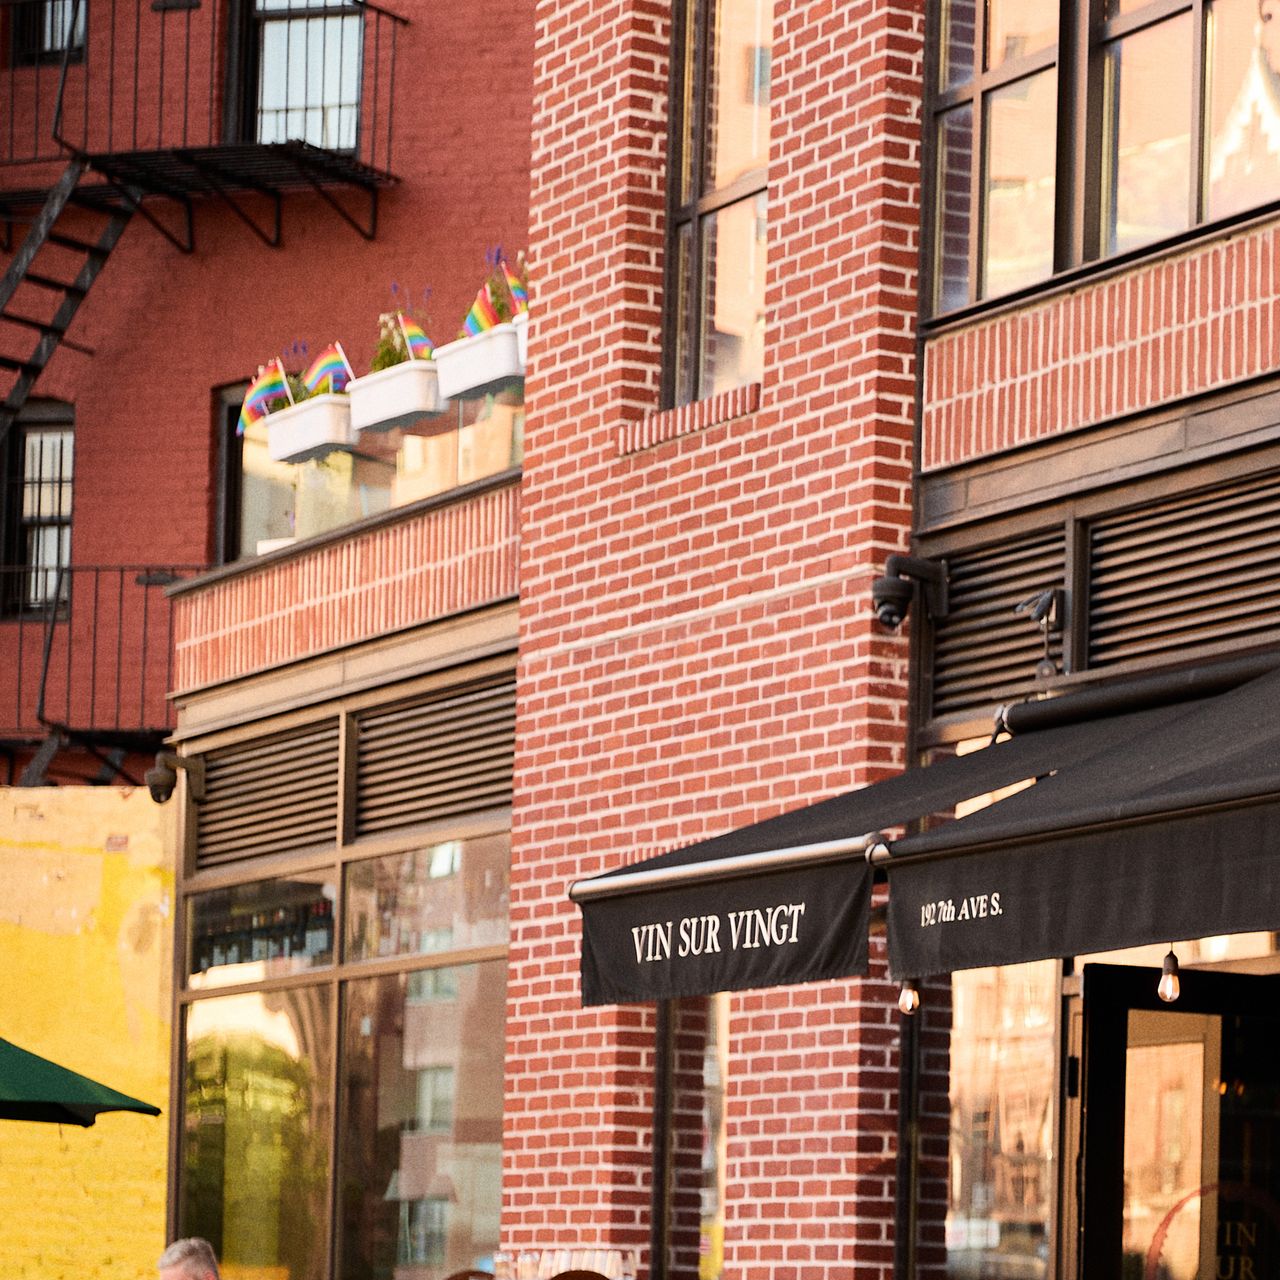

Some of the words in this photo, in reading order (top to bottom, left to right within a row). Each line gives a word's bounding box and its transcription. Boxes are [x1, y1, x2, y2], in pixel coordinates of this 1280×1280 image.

[631, 917, 673, 964] VIN
[678, 913, 721, 957] SUR
[728, 902, 806, 950] VINGT
[920, 902, 937, 927] 192
[937, 899, 956, 923] 7th
[957, 894, 989, 921] AVE
[990, 892, 1003, 916] S.
